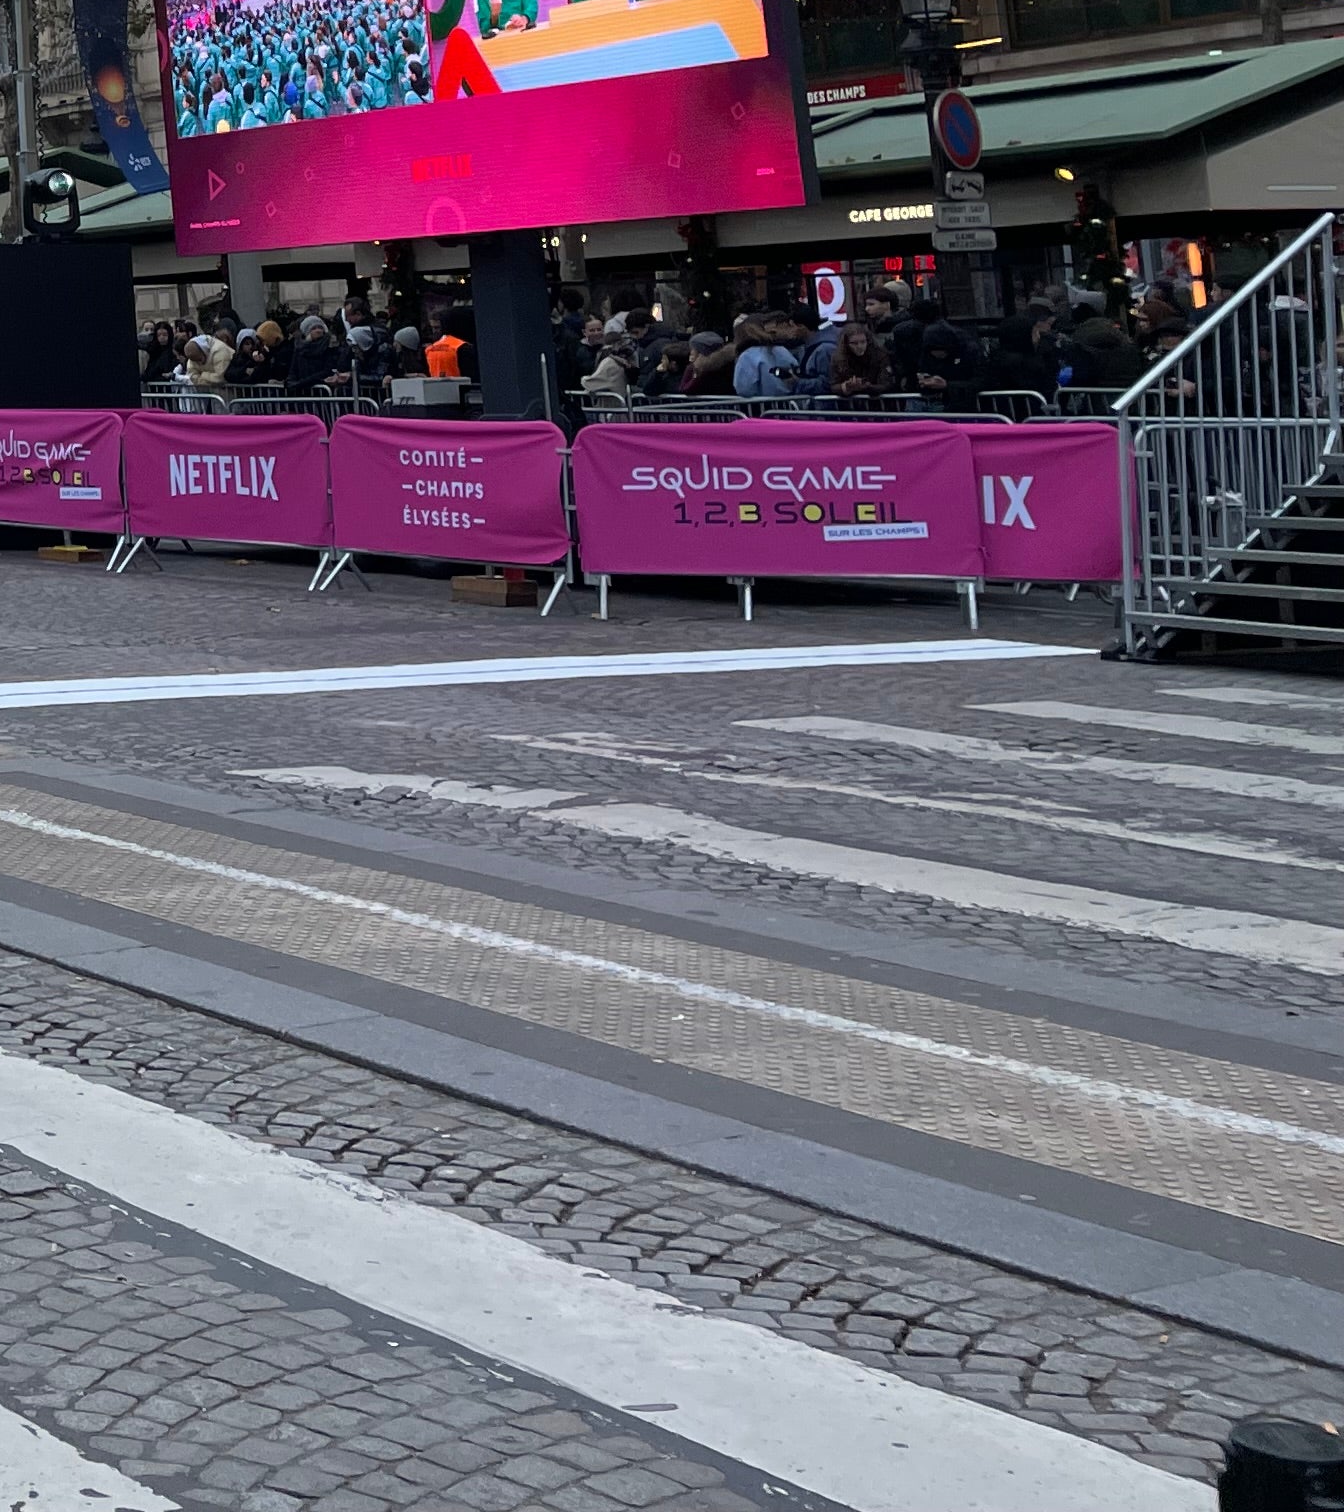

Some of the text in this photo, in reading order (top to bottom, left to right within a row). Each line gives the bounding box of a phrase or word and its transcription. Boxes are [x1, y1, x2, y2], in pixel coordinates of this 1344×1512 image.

[807, 85, 866, 104] DES CHAMPS
[849, 204, 934, 223] CAFE GEORGE
[34, 442, 91, 468] GAME
[169, 454, 279, 500] NETFLIX
[622, 454, 896, 501] SQUID GAME
[774, 501, 912, 525] SOLEIL
